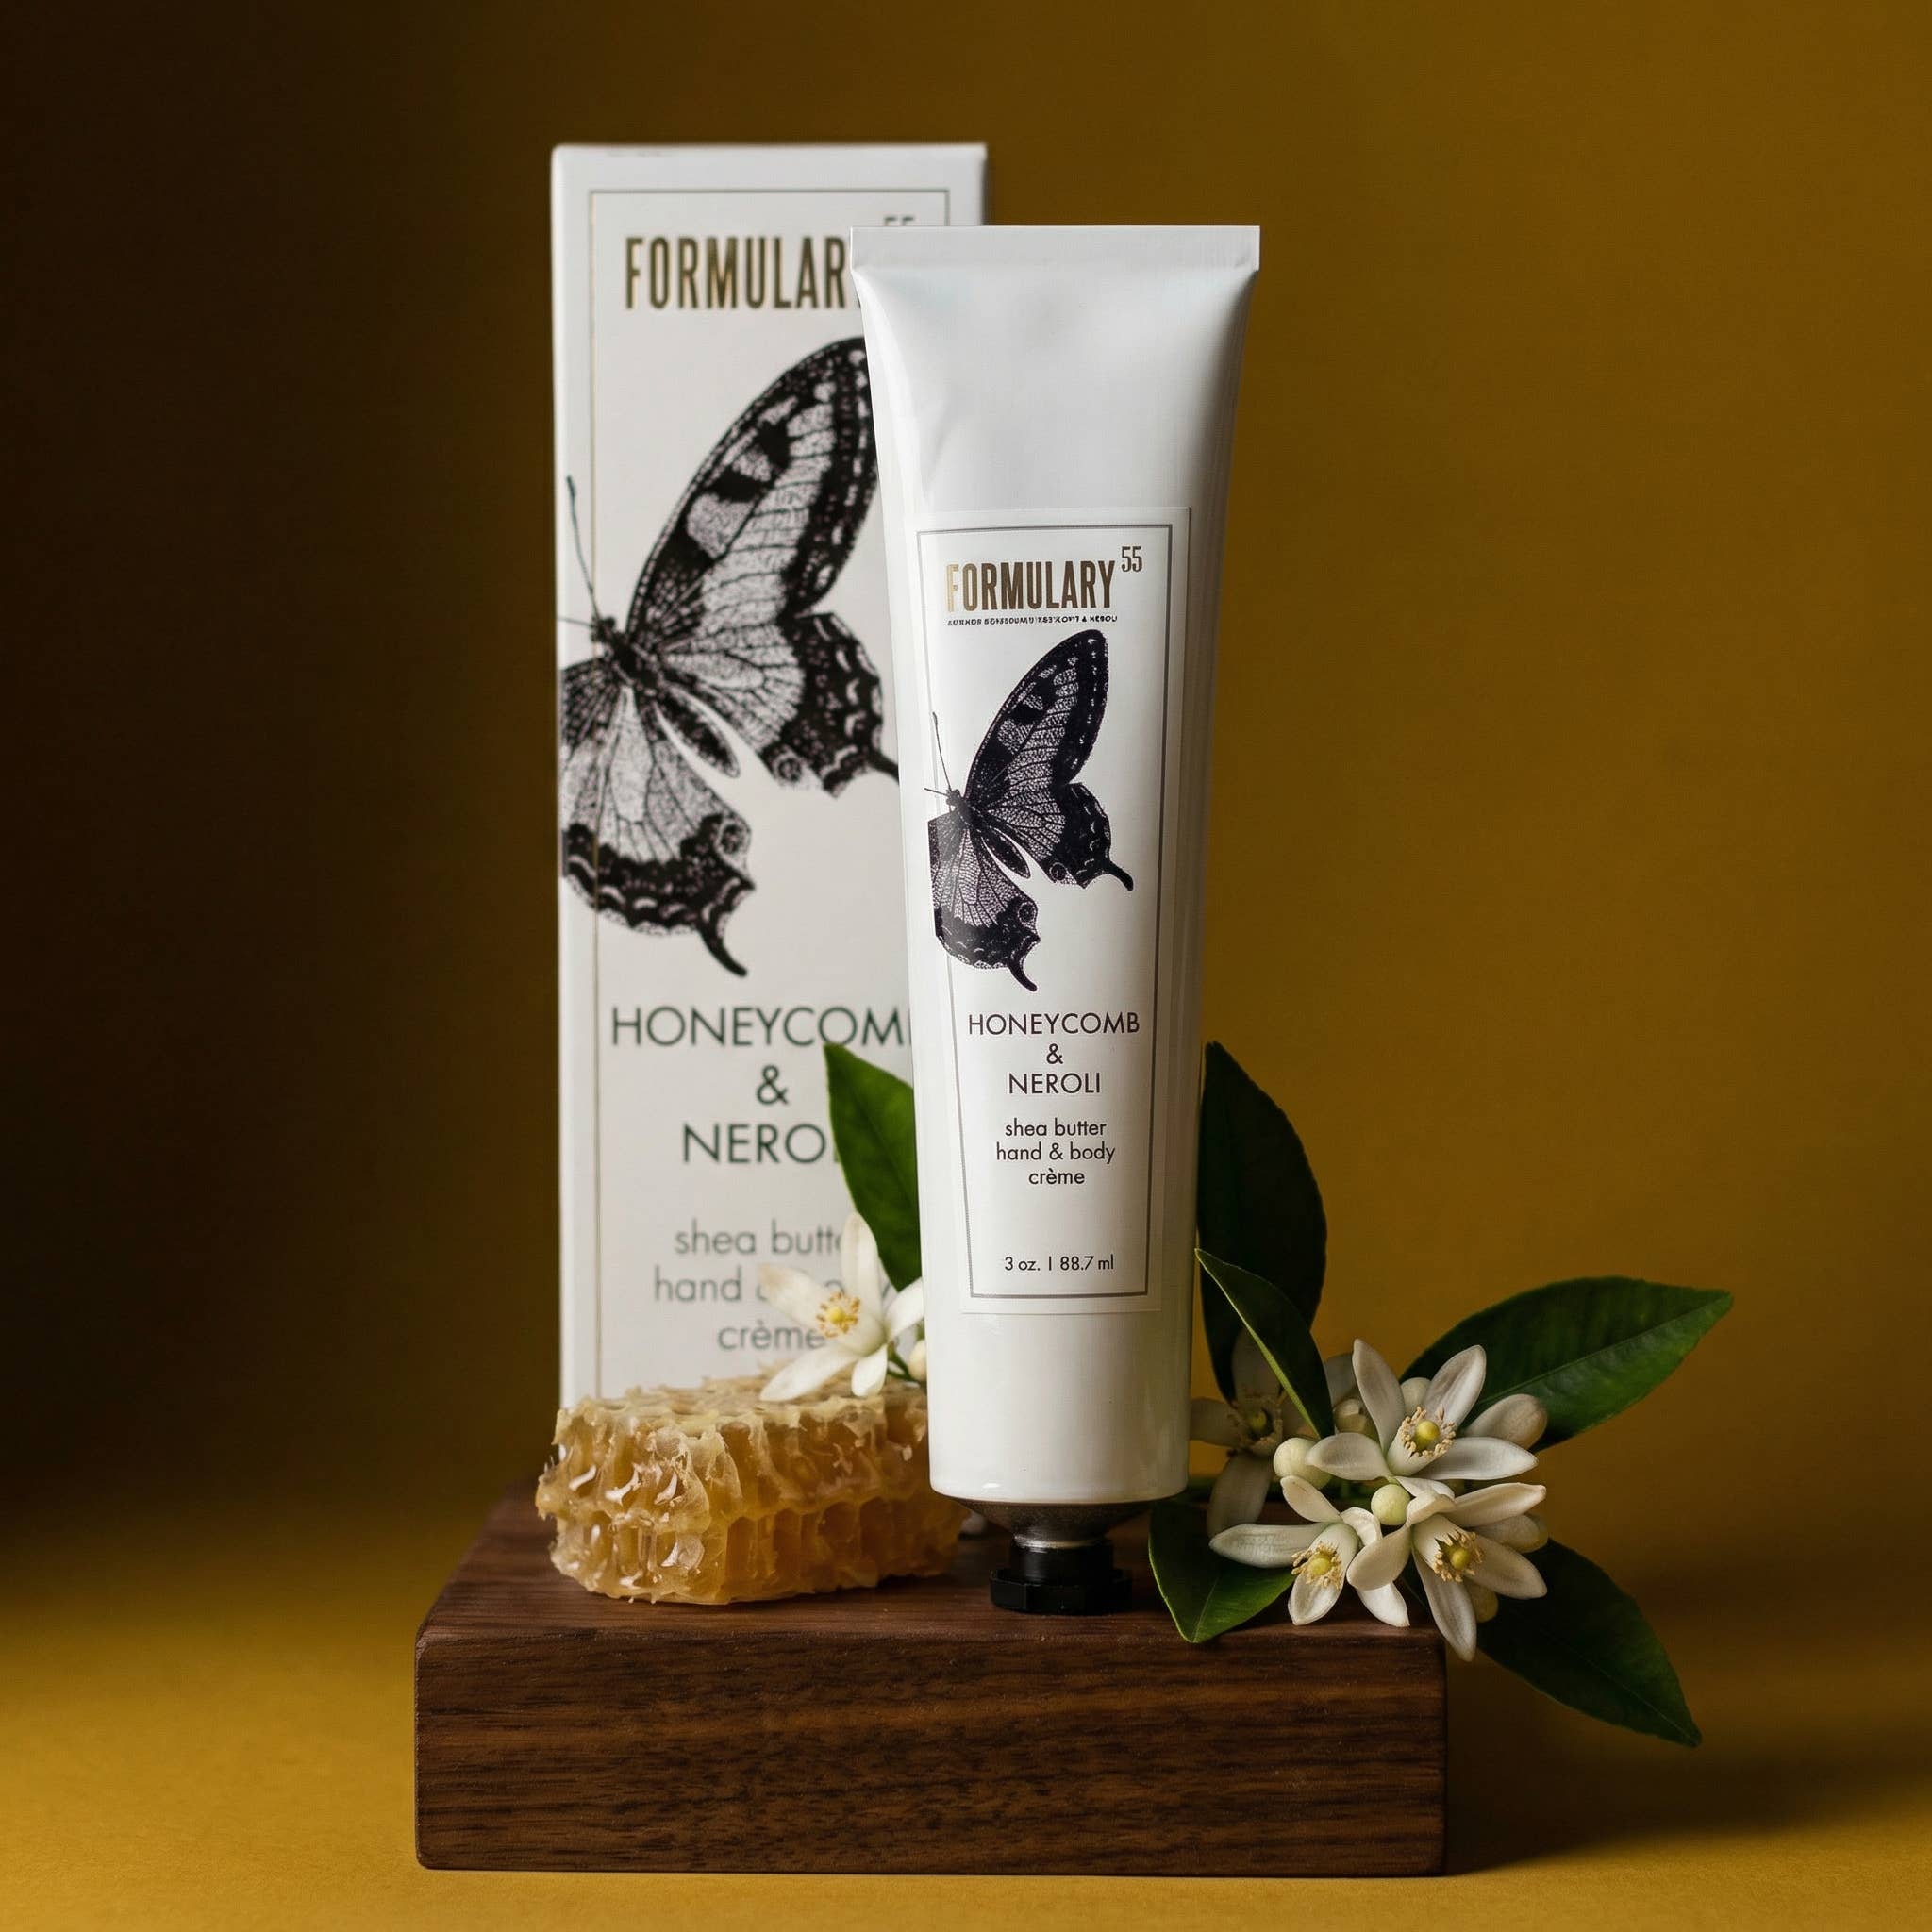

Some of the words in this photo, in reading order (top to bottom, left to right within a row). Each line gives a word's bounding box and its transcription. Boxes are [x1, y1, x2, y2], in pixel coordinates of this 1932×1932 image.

[625, 235, 860, 309] FORMULAR
[947, 560, 1116, 612] FORMULARY
[1121, 546, 1143, 573] 55
[612, 1006, 911, 1047] HONEYCOM
[969, 1012, 1140, 1035] HONEYCOMB
[1046, 1042, 1064, 1065] &
[756, 1064, 790, 1107] &
[1009, 1073, 1101, 1094] NEROLI
[1005, 1117, 1047, 1137] shea
[1055, 1117, 1107, 1137] butter
[683, 1122, 841, 1165] NERO
[996, 1142, 1042, 1161] hand
[1049, 1141, 1064, 1161] &
[1070, 1141, 1116, 1165] body
[1028, 1168, 1086, 1186] crème
[675, 1217, 757, 1257] shea
[1005, 1256, 1015, 1272] 3
[1018, 1260, 1041, 1272] oz.
[1060, 1256, 1095, 1272] 88.7
[1098, 1254, 1115, 1271] ml
[654, 1264, 743, 1304] hand
[717, 1321, 827, 1352] crème
